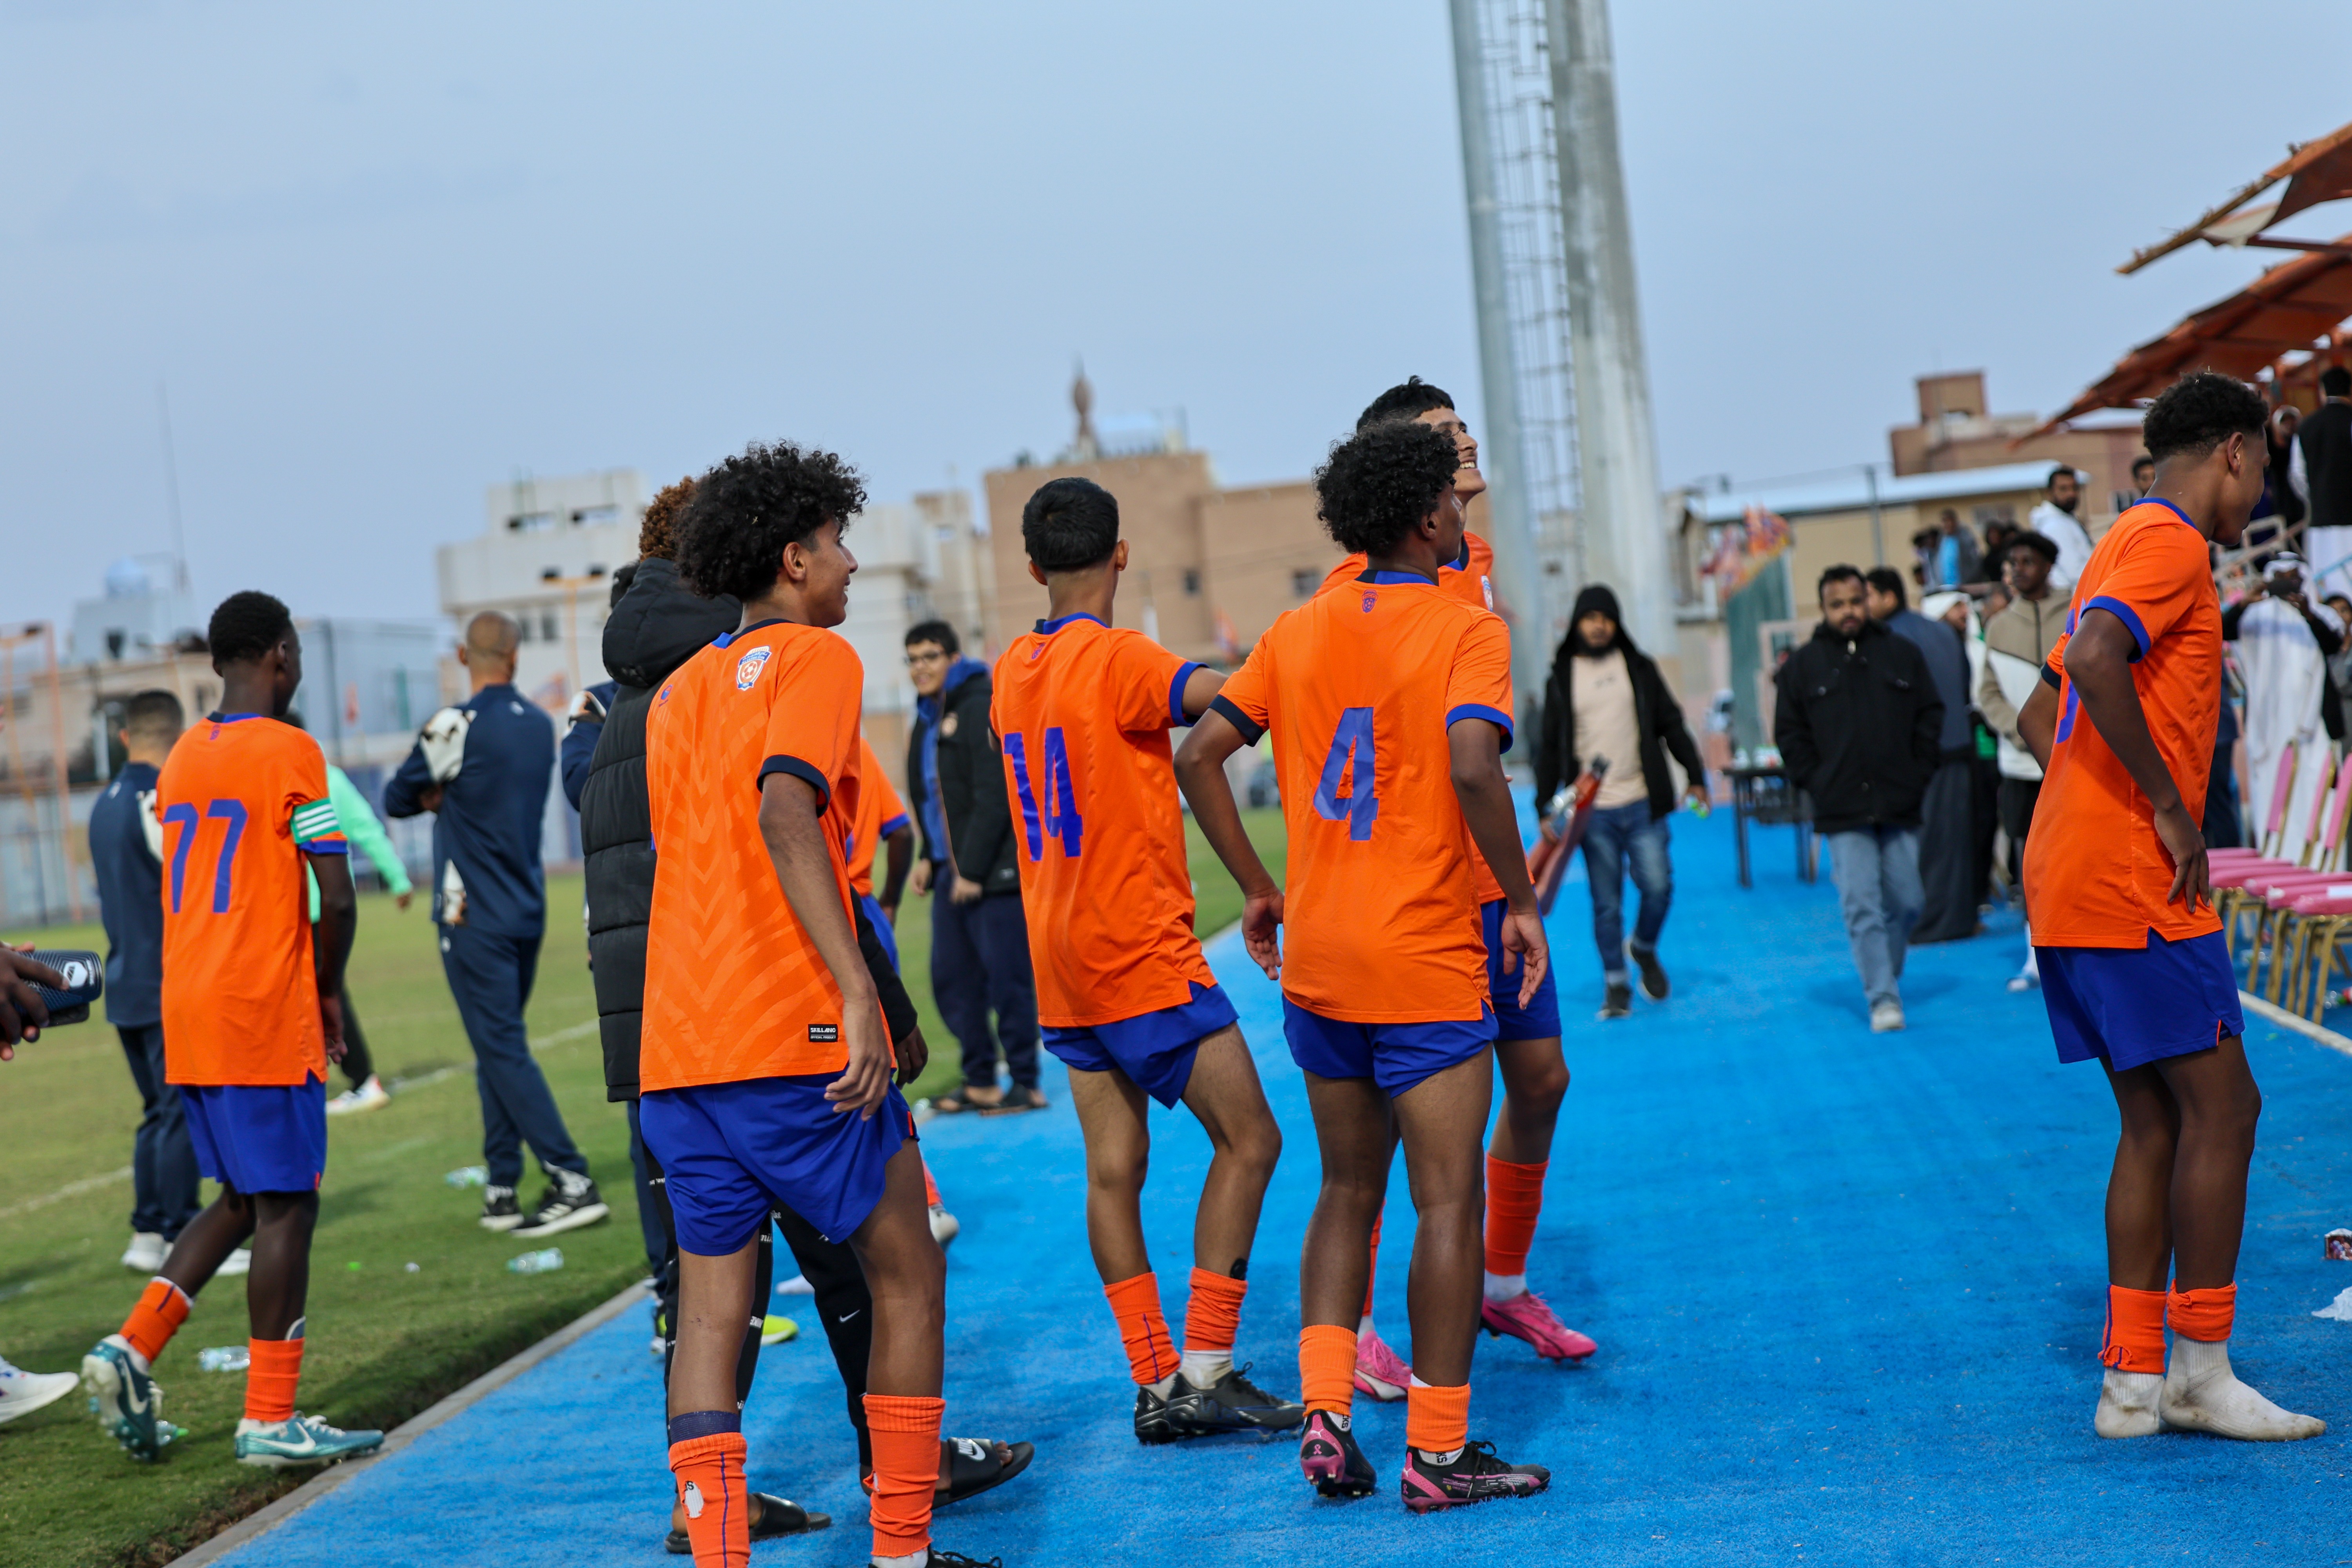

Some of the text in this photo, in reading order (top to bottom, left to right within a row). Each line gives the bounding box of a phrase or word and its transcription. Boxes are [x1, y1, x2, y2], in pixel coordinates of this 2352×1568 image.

[1004, 727, 1083, 862] 14
[1313, 706, 1379, 841] 4
[163, 799, 249, 914] 77
